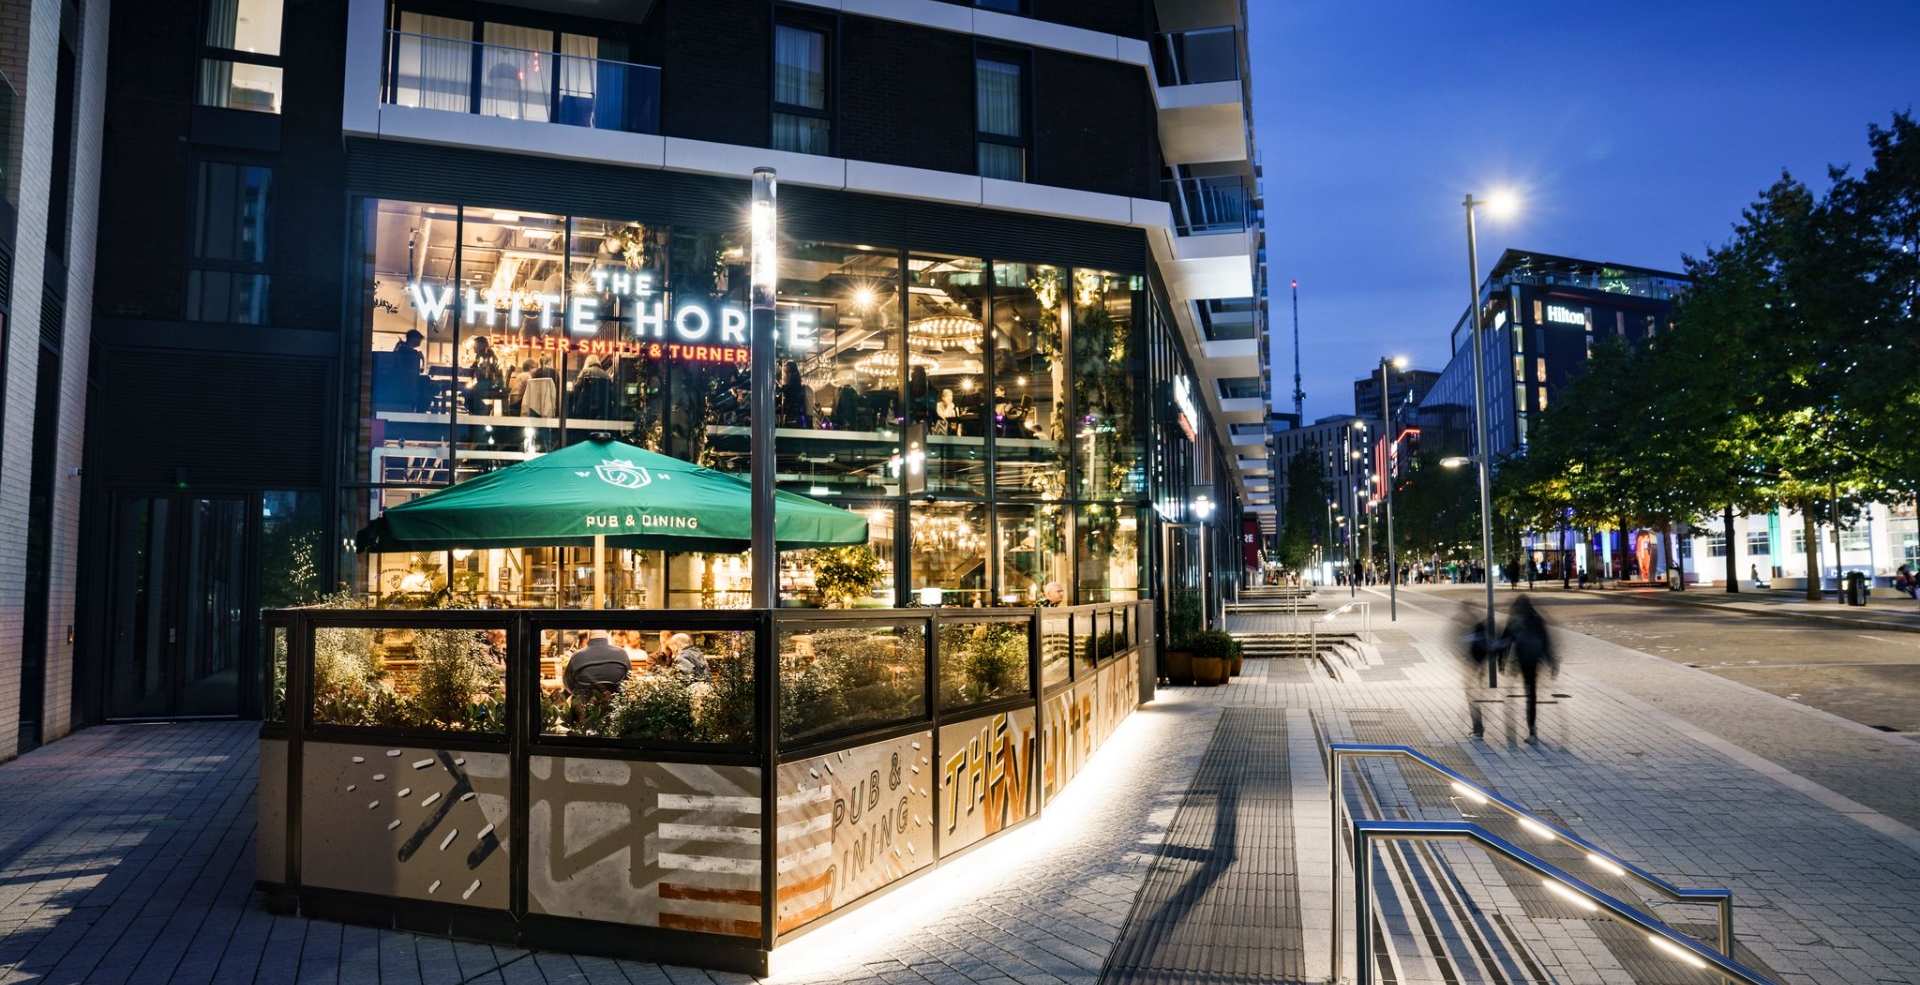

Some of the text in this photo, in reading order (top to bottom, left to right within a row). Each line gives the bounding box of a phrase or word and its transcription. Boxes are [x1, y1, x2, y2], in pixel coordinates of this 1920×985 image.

[591, 271, 652, 296] THE
[410, 284, 815, 347] WHITE HORE
[1547, 304, 1585, 326] Hilton
[490, 333, 748, 362] FULLER SMITH & TURNER
[574, 470, 590, 478] W
[586, 514, 699, 529] PUB & DINING
[945, 712, 1009, 836] THE
[831, 751, 903, 845] PUB &
[823, 795, 910, 907] DINING
